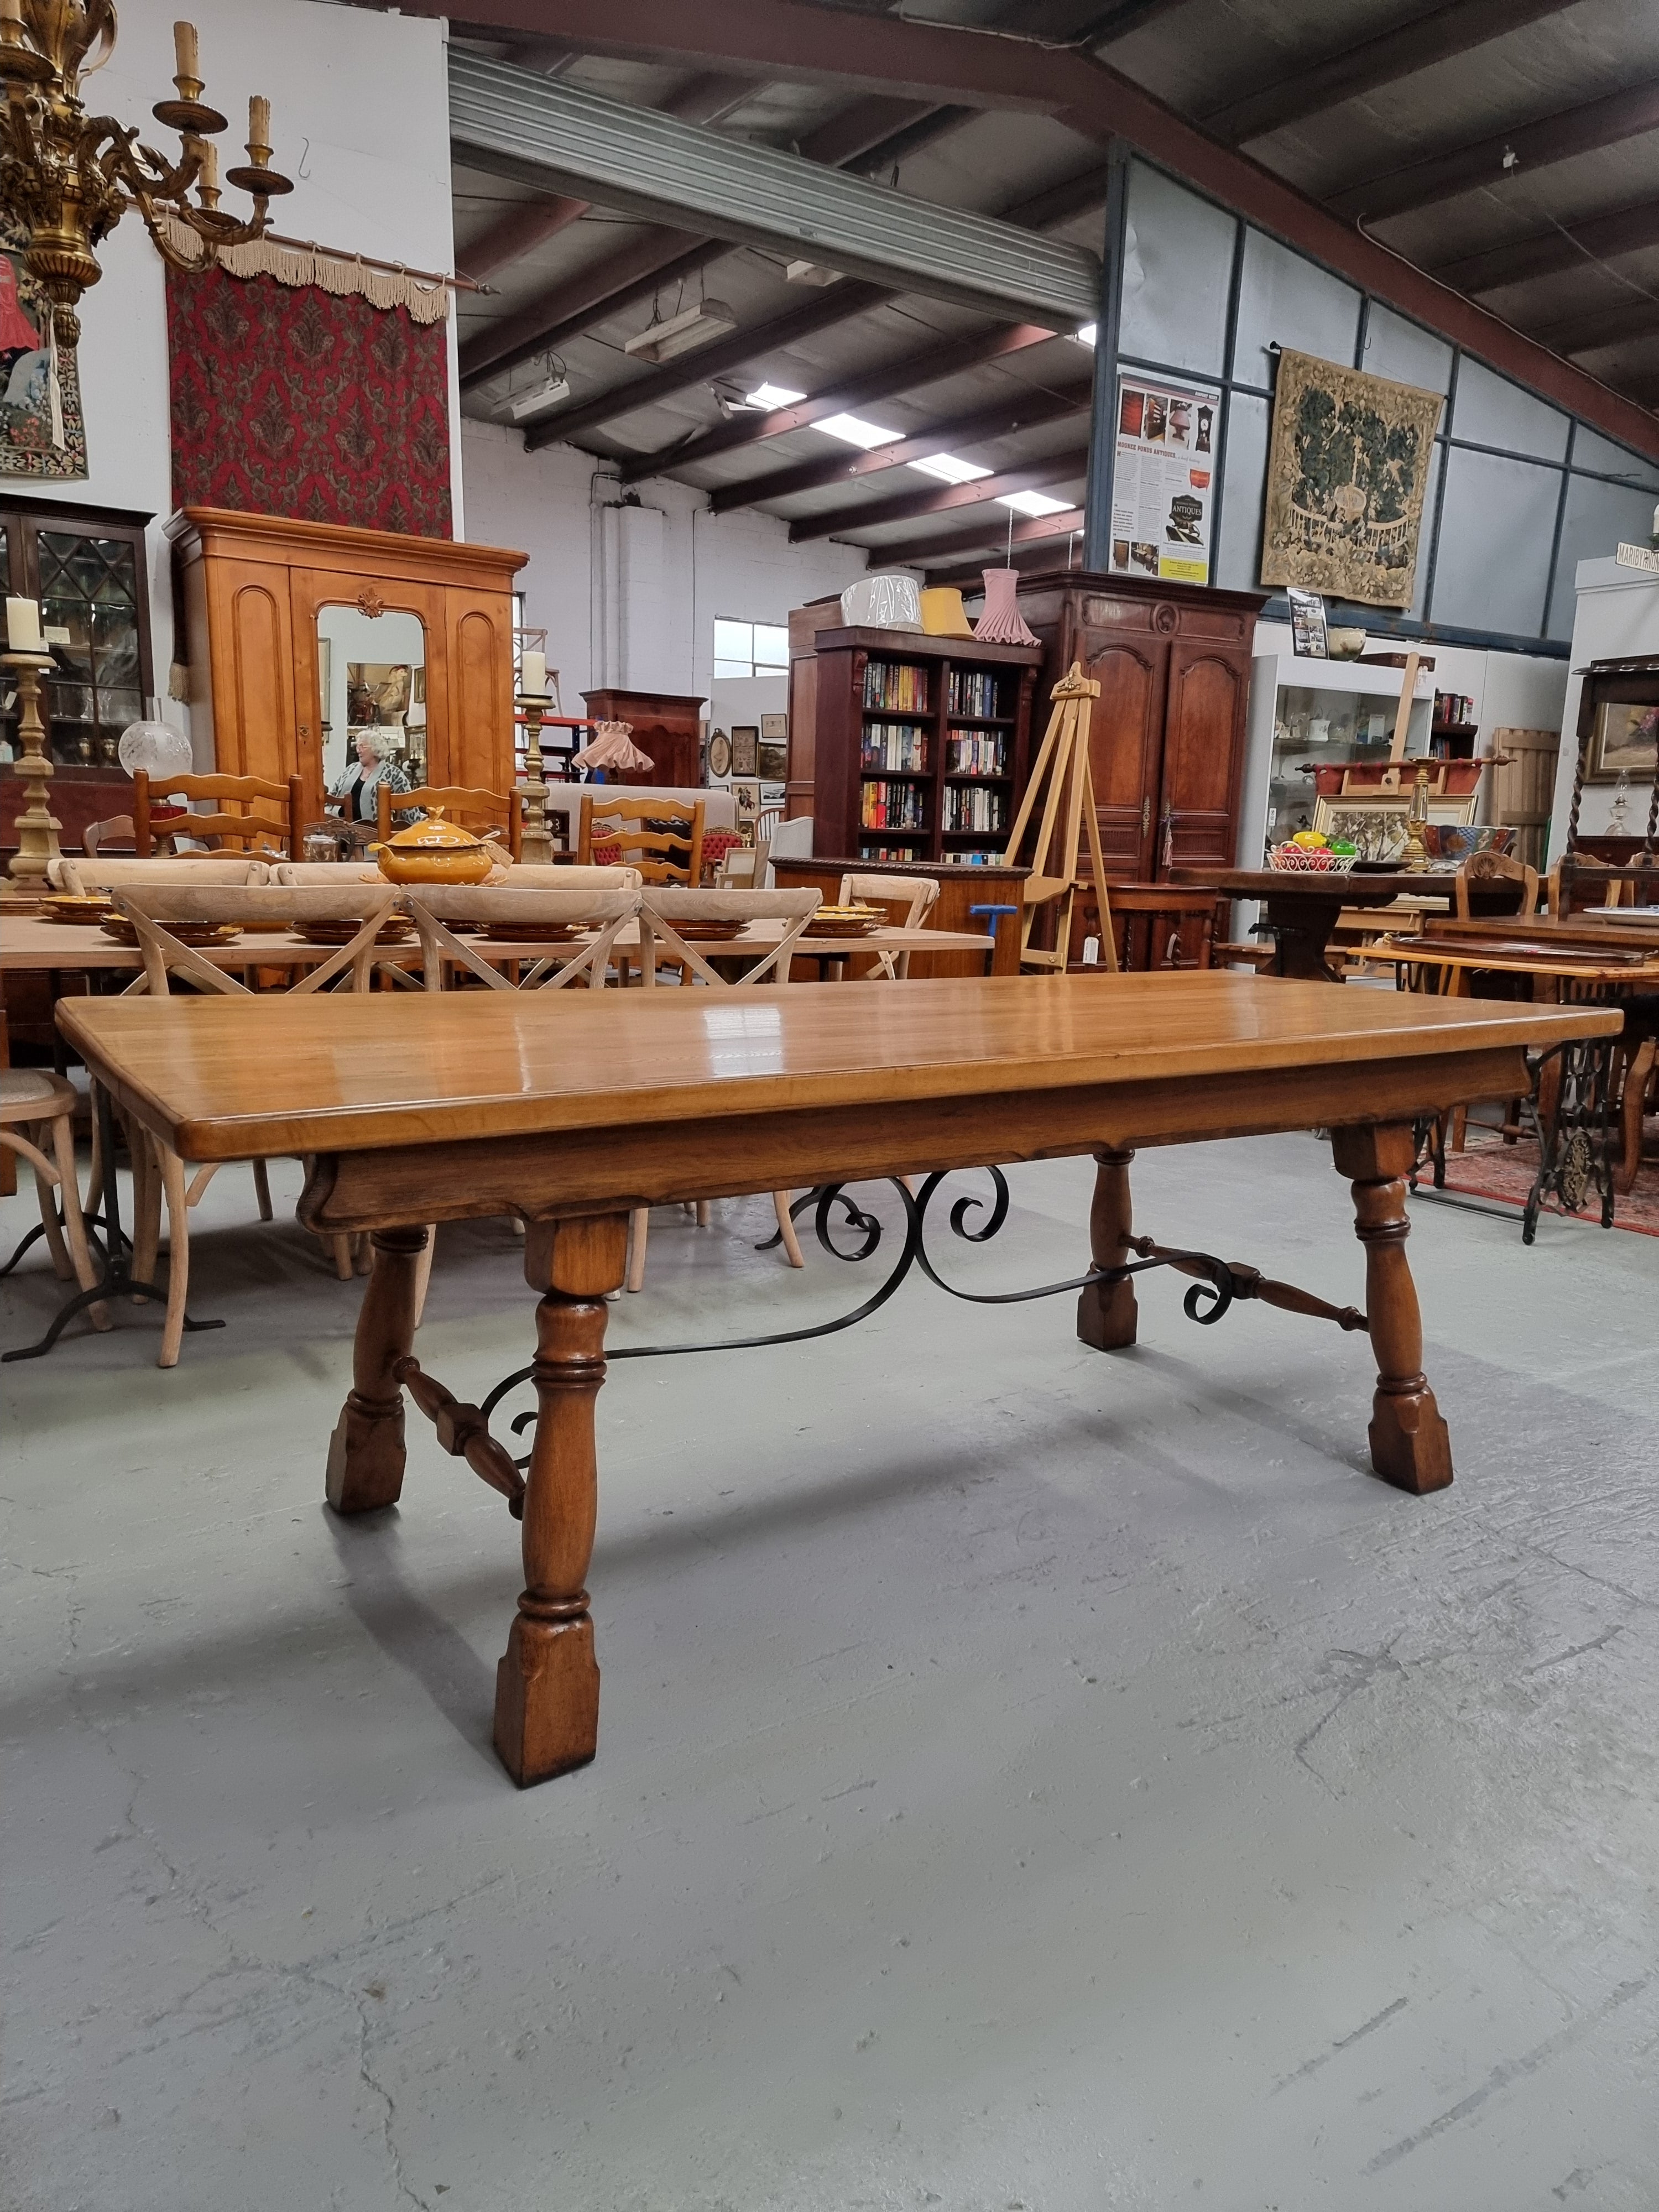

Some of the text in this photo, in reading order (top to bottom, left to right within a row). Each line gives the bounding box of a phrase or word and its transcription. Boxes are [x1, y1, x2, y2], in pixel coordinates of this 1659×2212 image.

[1118, 441, 1136, 451] MOONEE
[1137, 445, 1152, 453] PONDS
[1172, 505, 1202, 515] ANTIQUES
